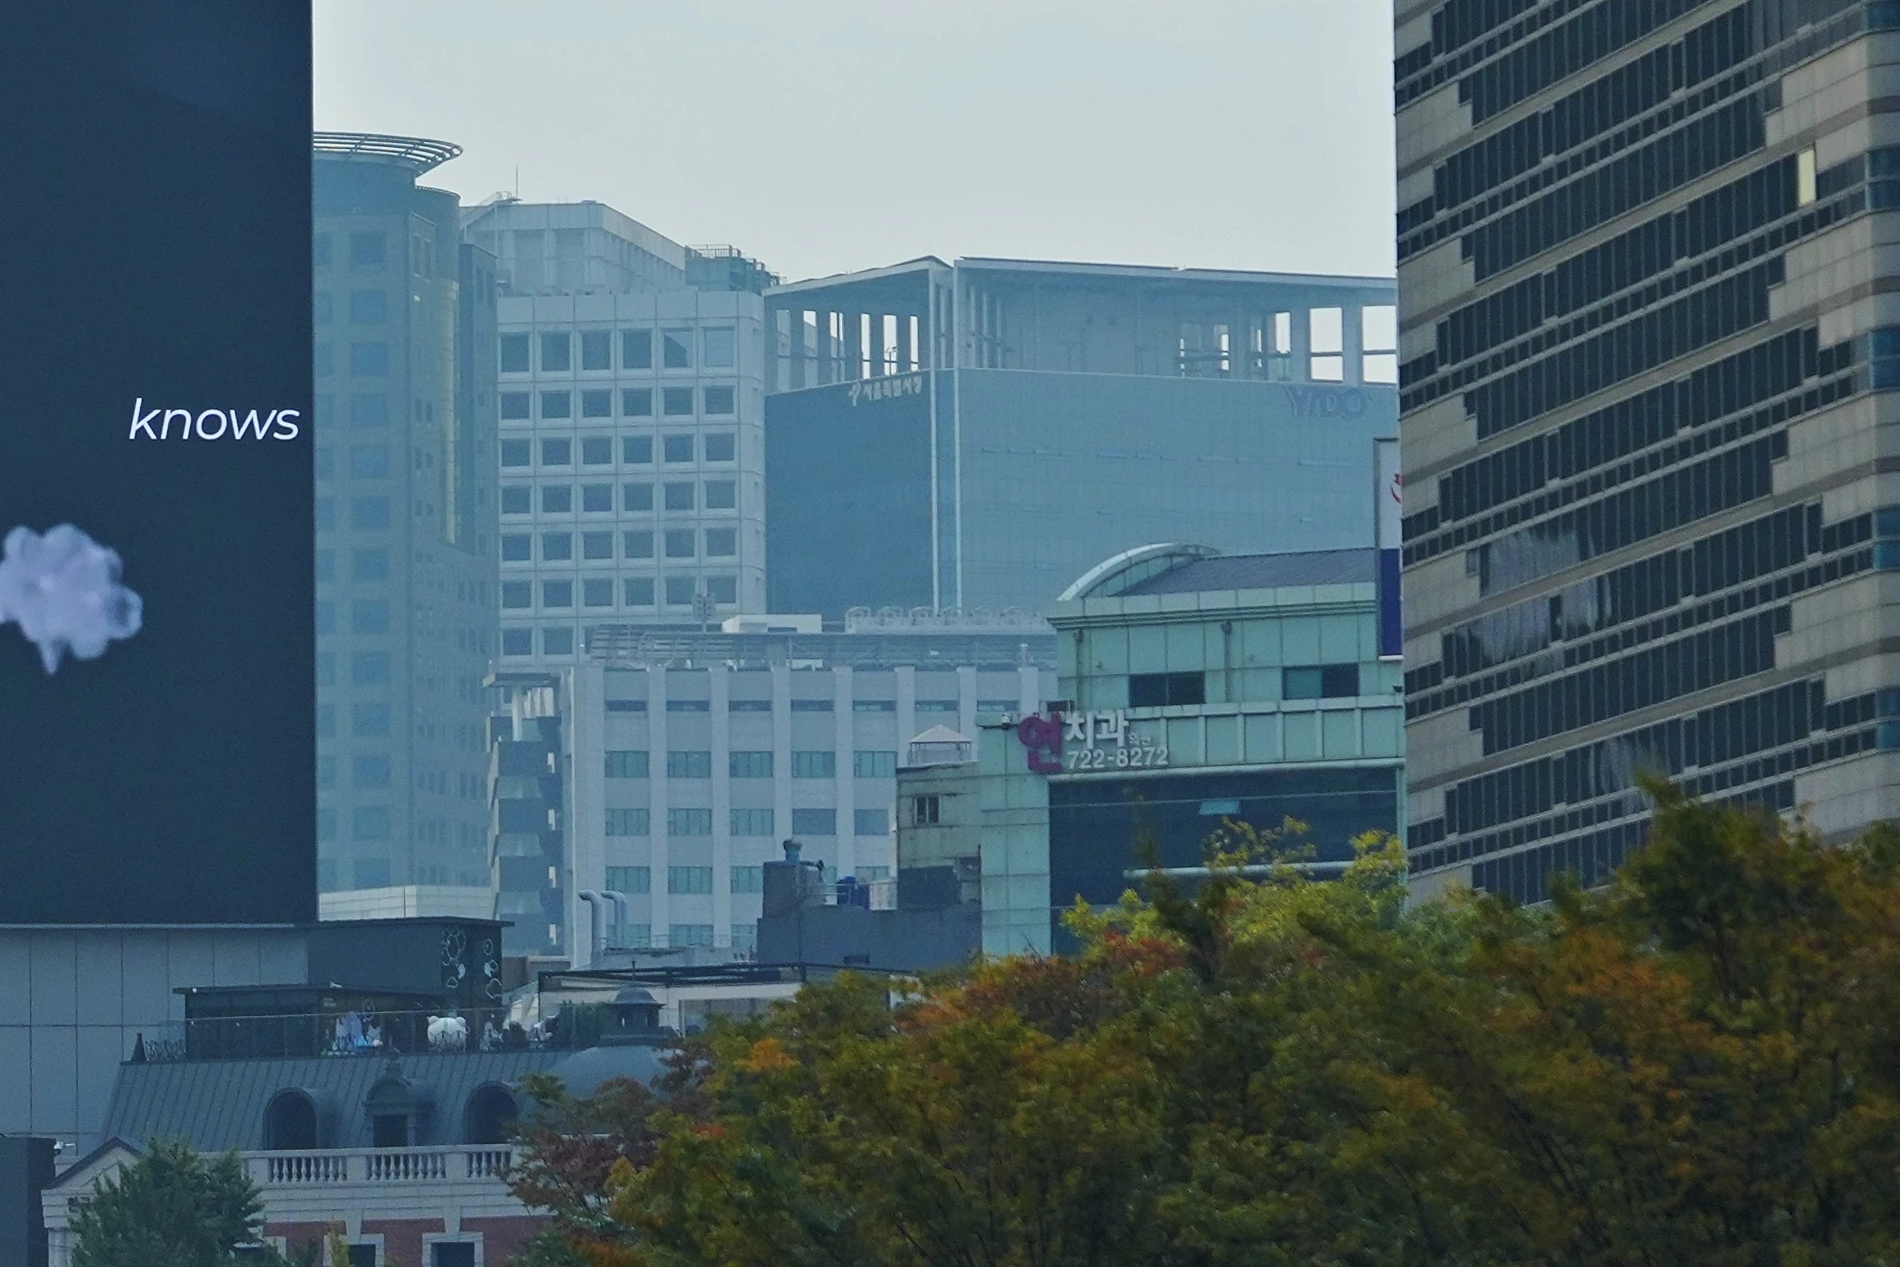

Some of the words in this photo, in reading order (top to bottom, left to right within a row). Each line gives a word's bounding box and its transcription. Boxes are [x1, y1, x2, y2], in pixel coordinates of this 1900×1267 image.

[129, 397, 300, 441] knows
[1065, 710, 1129, 749] 치과
[1067, 747, 1168, 770] 722-8272
